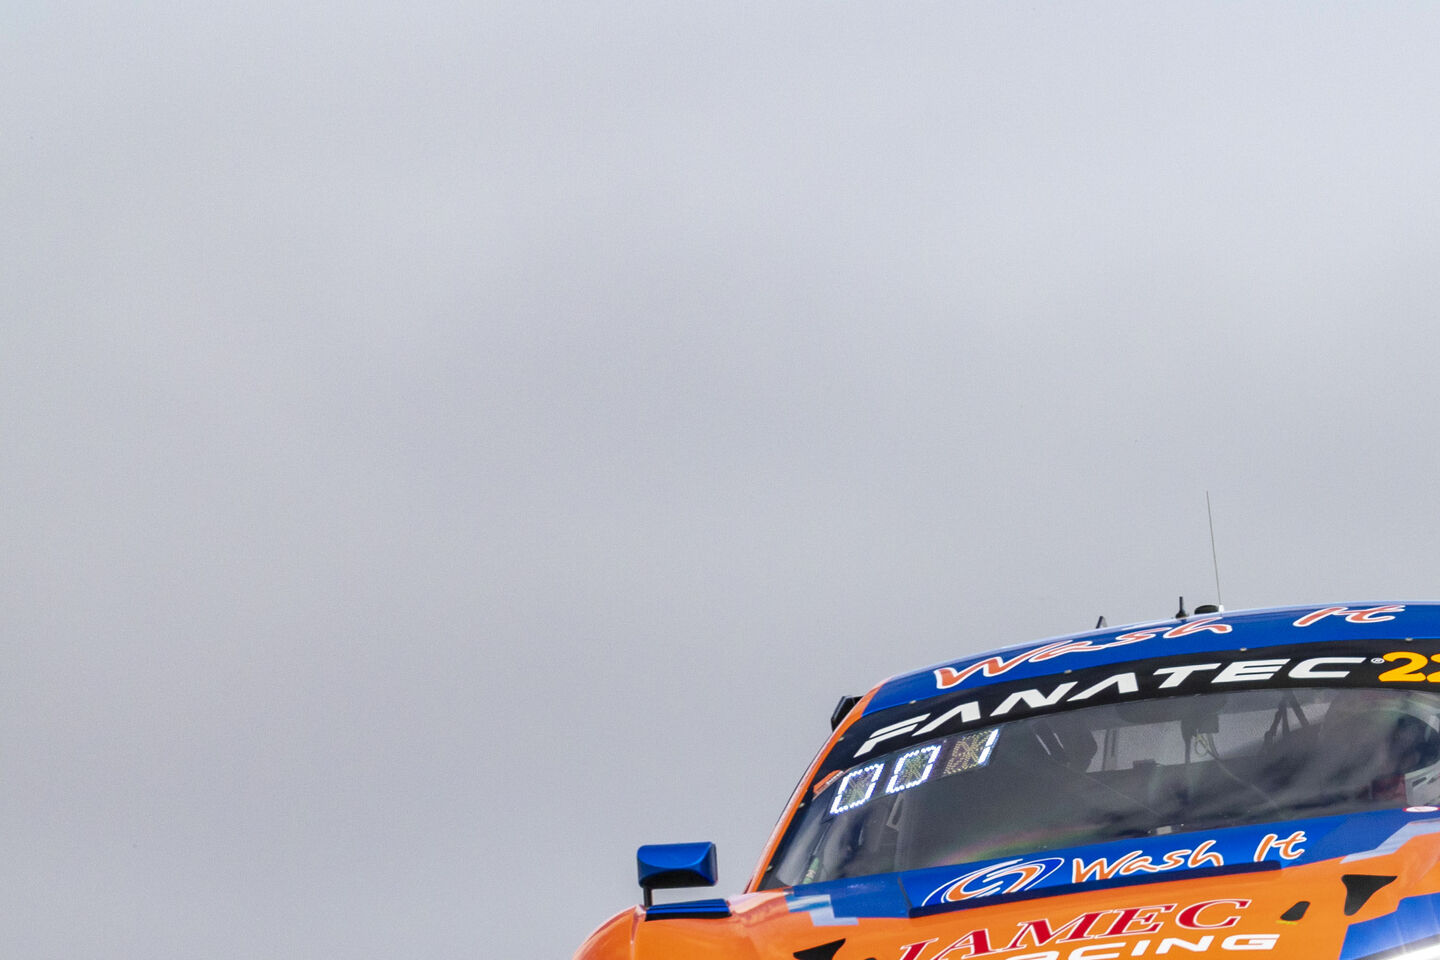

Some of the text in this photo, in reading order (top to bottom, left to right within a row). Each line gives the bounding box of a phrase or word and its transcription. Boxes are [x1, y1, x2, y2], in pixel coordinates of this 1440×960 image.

[933, 616, 1234, 690] Wash
[1072, 830, 1307, 885] Wash It
